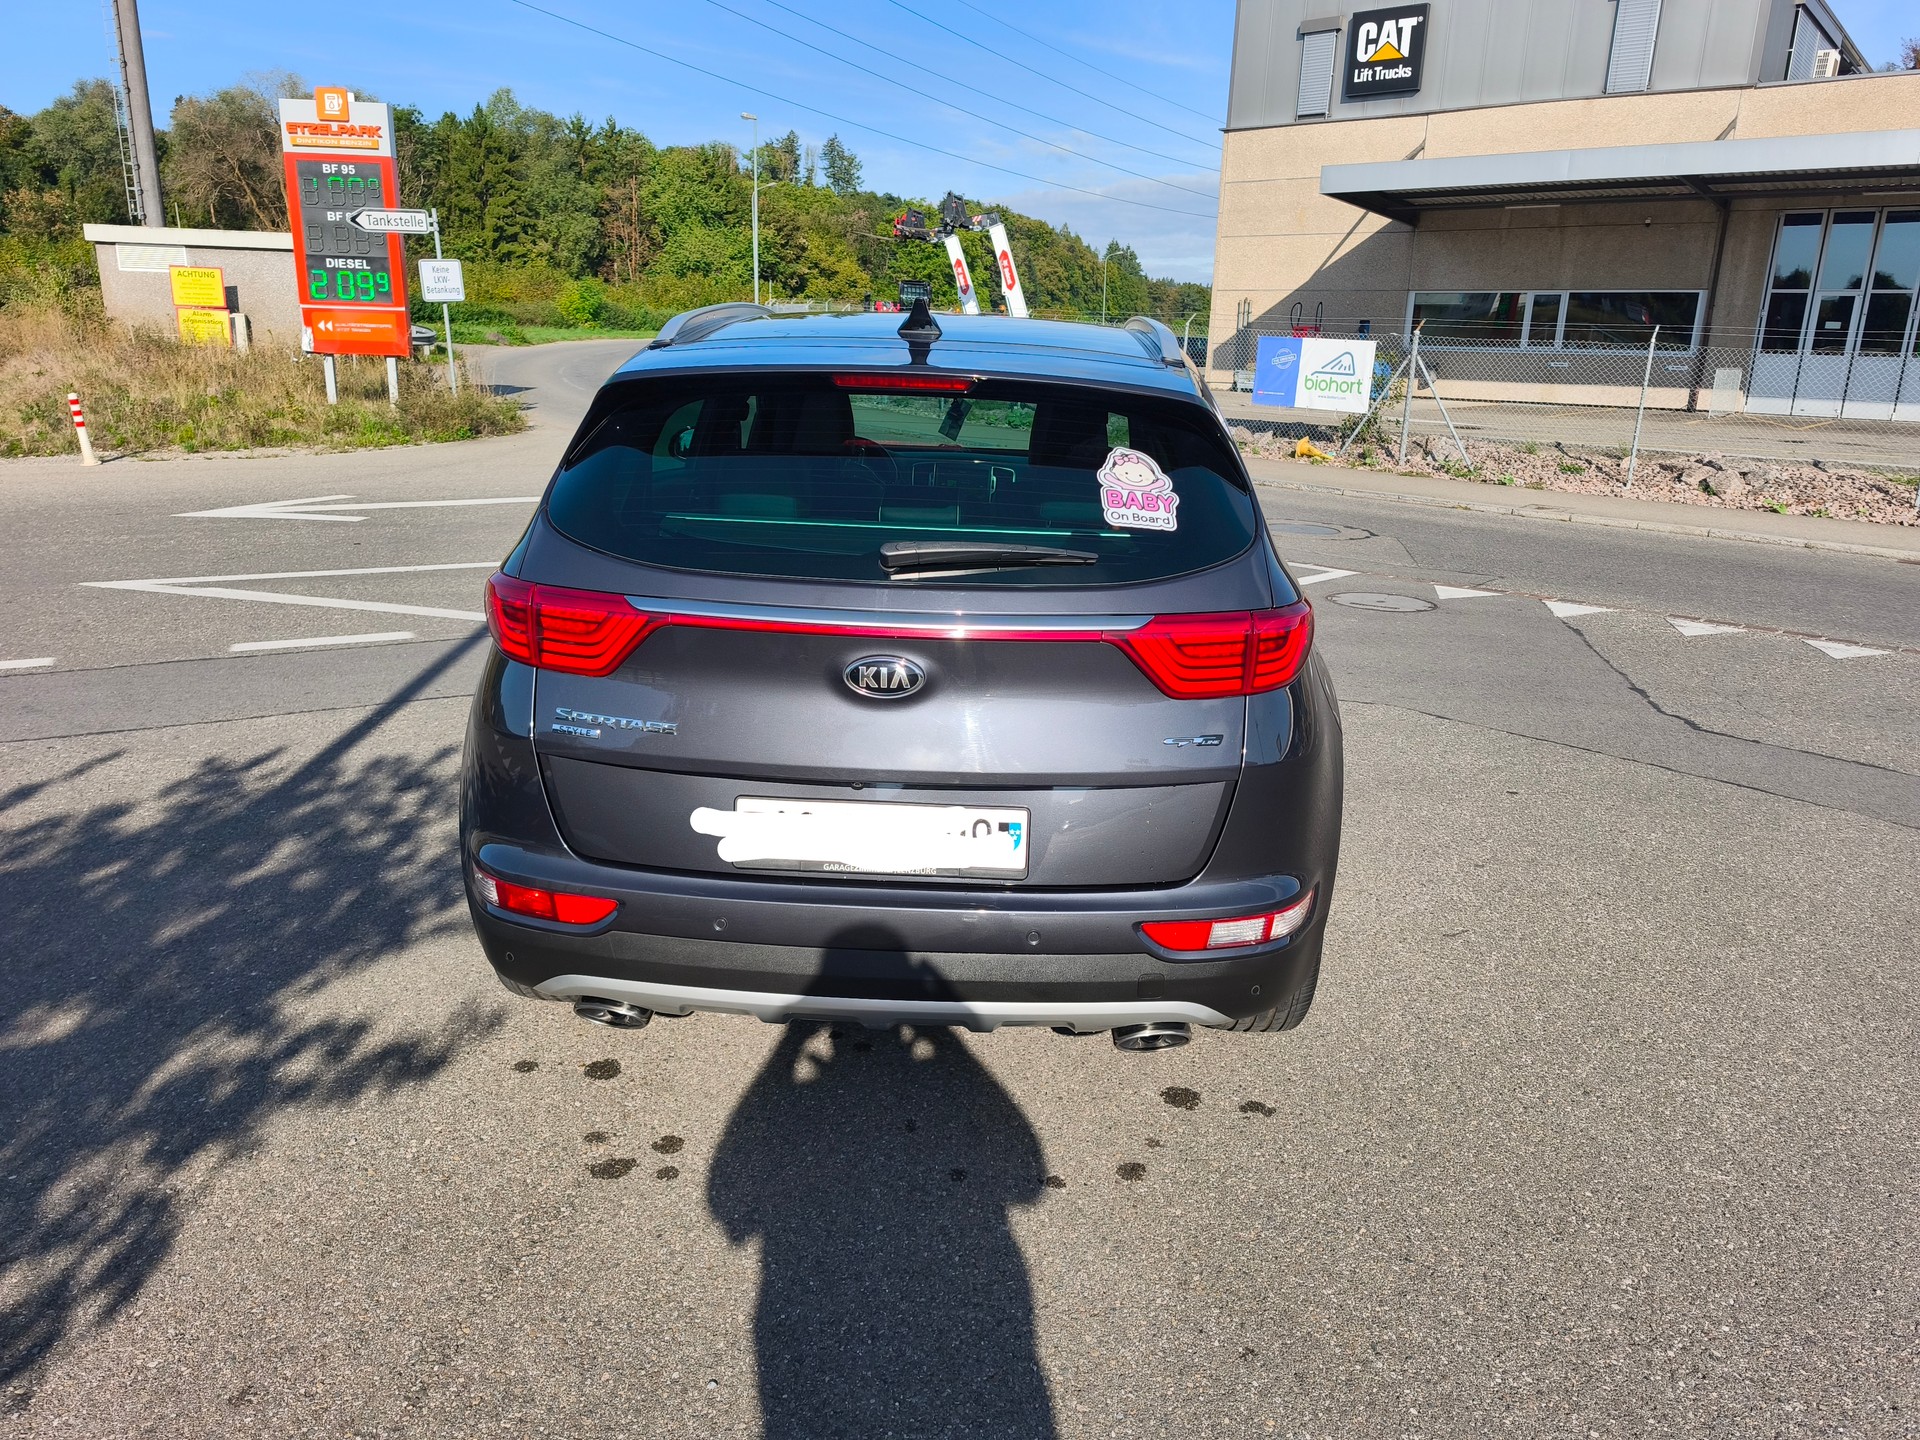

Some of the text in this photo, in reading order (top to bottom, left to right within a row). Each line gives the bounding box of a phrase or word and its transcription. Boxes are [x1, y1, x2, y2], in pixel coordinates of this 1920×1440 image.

[1357, 17, 1418, 62] CAT
[1353, 64, 1412, 82] Lift Trucks
[286, 122, 382, 138] ETZELPARK
[296, 138, 373, 147] DINTIKON BENZIN
[322, 163, 356, 175] BF 95
[327, 211, 343, 222] BF
[366, 214, 424, 228] Tankstelle
[325, 258, 371, 270] DIESEL
[431, 265, 450, 274] Keine
[177, 270, 216, 279] ACHTUNG
[434, 276, 451, 285] LKW-
[426, 286, 461, 296] Betankung
[1304, 375, 1363, 394] biohort
[1106, 489, 1174, 513] BABY
[1111, 511, 1170, 525] On Board
[858, 664, 911, 689] KIA
[555, 707, 678, 736] SPORTAGE
[559, 725, 592, 737] STYLE
